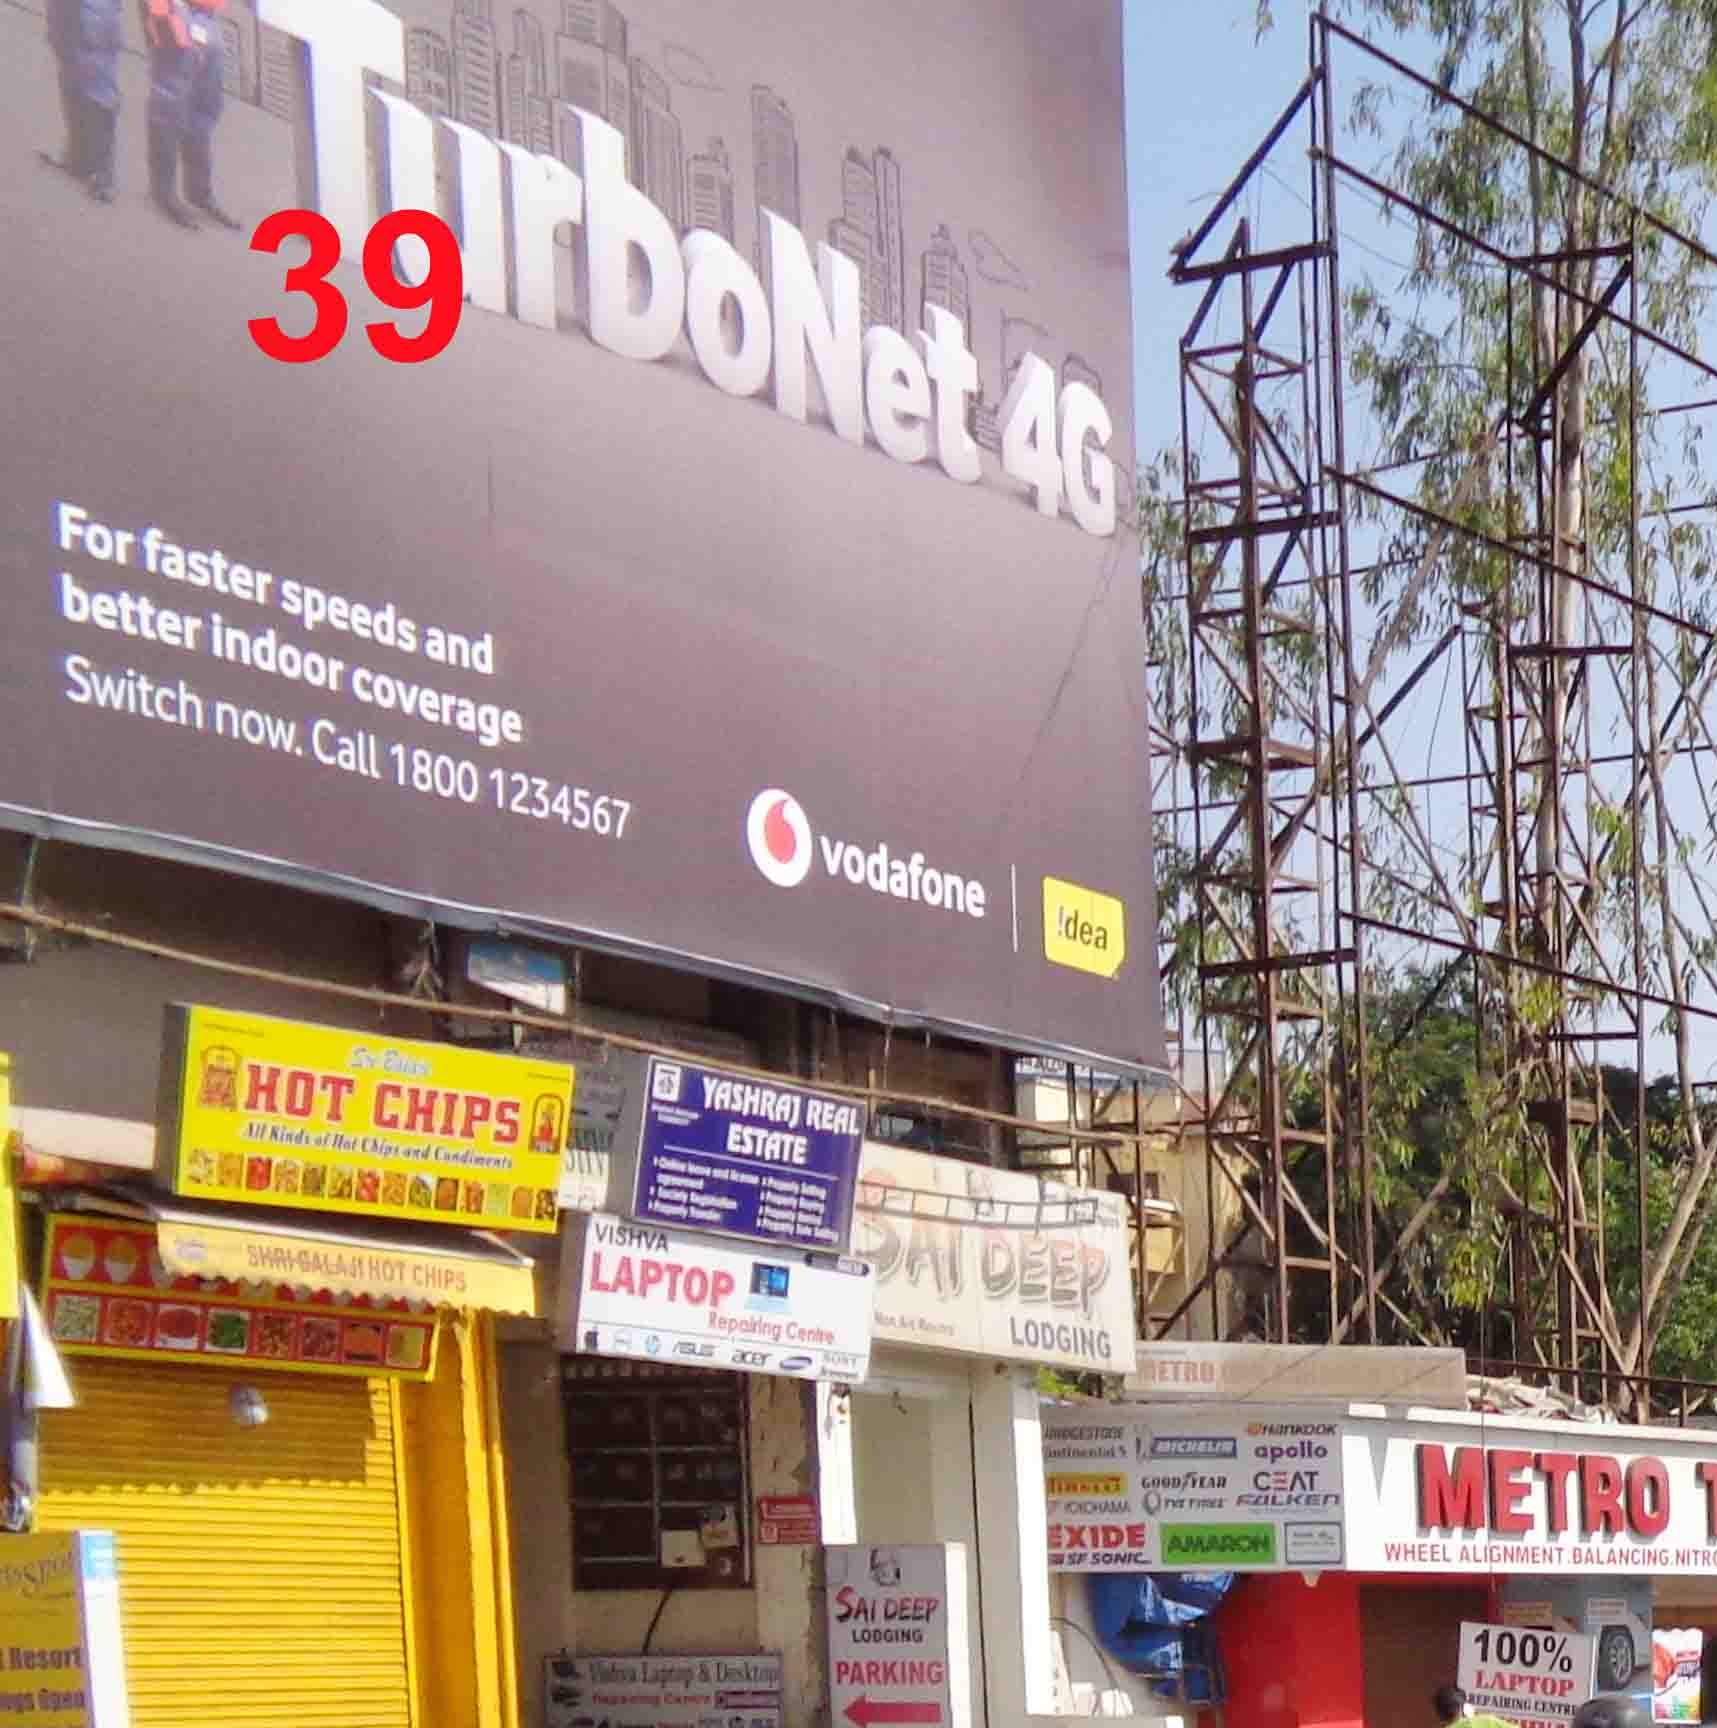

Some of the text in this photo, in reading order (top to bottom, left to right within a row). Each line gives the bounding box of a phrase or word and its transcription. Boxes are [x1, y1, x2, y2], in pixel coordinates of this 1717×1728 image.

[255, 0, 1117, 538] TurboNet 4G
[56, 502, 495, 675] For faster speeds and
[60, 574, 525, 747] better indoor coverage
[63, 654, 631, 840] Switch now. Call 1800 1234567
[819, 834, 986, 918] vodafone
[243, 1063, 521, 1145] HOT CHIPS
[702, 1075, 801, 1129] YASHRAJ
[805, 1098, 860, 1135] REAL
[243, 1121, 266, 1141] All
[268, 1125, 311, 1147] Kinds
[331, 1133, 357, 1153] Hot
[360, 1138, 400, 1160] Chips
[401, 1143, 430, 1161] and
[433, 1145, 514, 1170] Condiments
[726, 1121, 808, 1166] ESTATE
[595, 1223, 670, 1254] VISHVA
[367, 1257, 407, 1282] HOT
[411, 1264, 467, 1291] CHIPS
[589, 1250, 736, 1308] LAPTOP
[980, 1230, 1113, 1321] DEEP
[708, 1310, 835, 1345] Repairing Centre
[1009, 1315, 1112, 1360] LODGING
[731, 1350, 773, 1368] acer
[1253, 1440, 1329, 1464] apollo
[1141, 1471, 1228, 1492] GOODYEAR
[1253, 1470, 1319, 1493] CEAT
[1415, 1443, 1671, 1541] METRO
[1048, 1522, 1146, 1550] EXIDE
[1166, 1536, 1272, 1554] AMARON
[1384, 1543, 1453, 1564] WHEEL
[1092, 1552, 1152, 1566] SONIC
[835, 1585, 939, 1623] SAI DEEP
[851, 1628, 924, 1643] LODGING
[1474, 1627, 1573, 1673] 100%
[835, 1660, 945, 1686] PARKING
[1474, 1668, 1576, 1697] LAPTOP
[1468, 1693, 1532, 1711] REPAIRING
